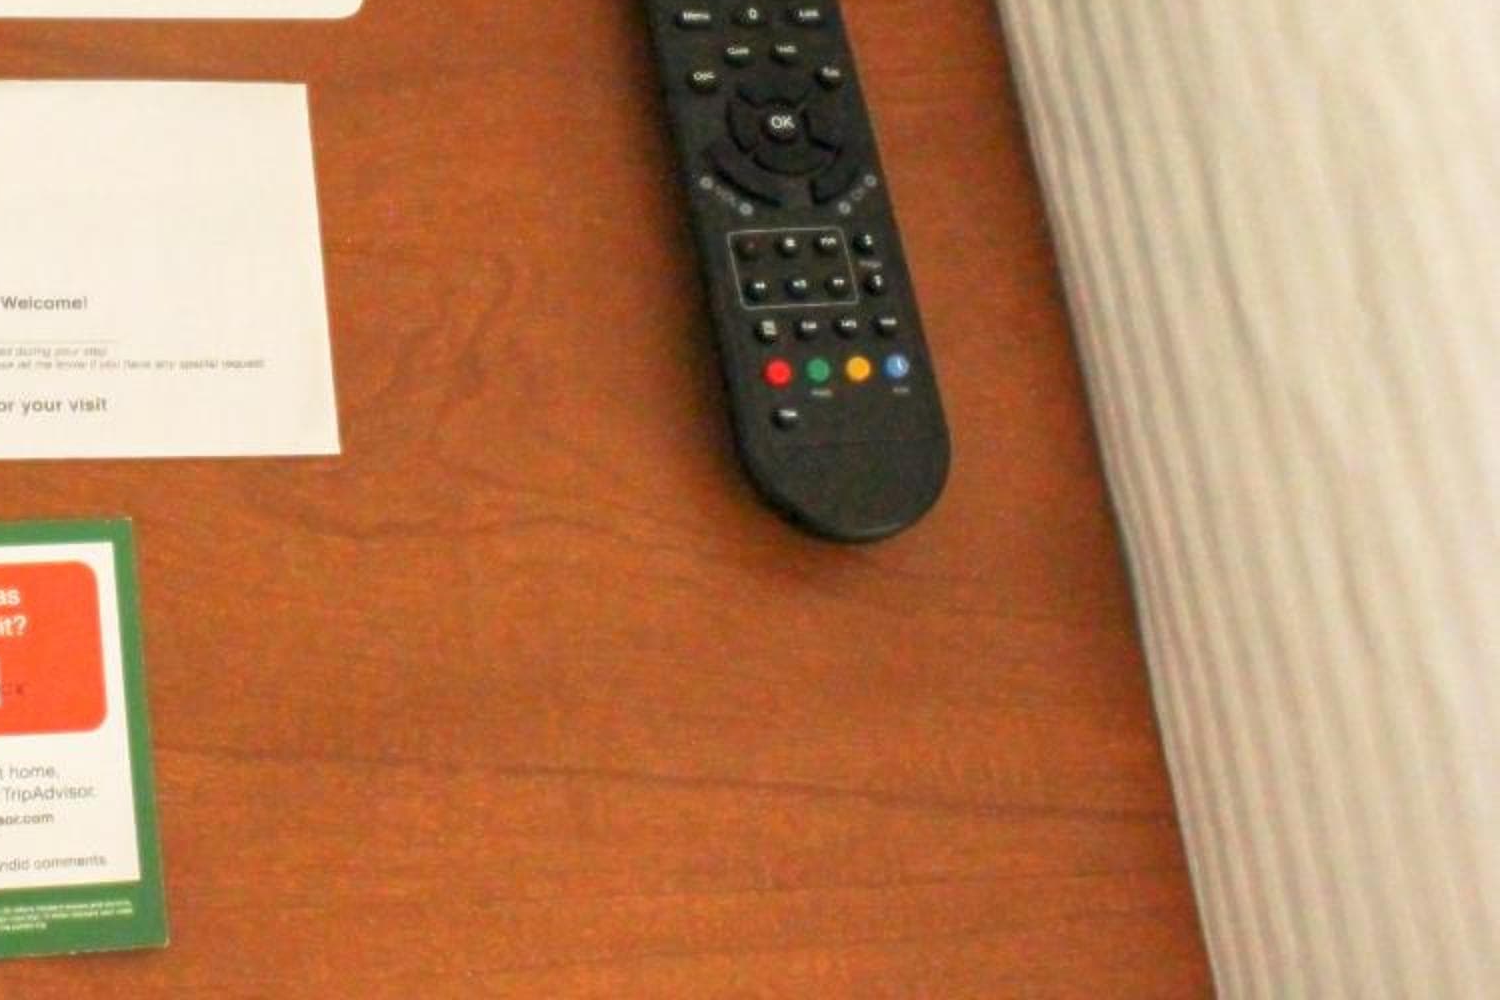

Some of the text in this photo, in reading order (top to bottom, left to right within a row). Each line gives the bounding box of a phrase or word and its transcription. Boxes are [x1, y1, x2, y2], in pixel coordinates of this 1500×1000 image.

[770, 116, 795, 129] OK
[0, 296, 88, 310] Welcome!
[21, 400, 63, 416] your
[68, 397, 108, 412] visit
